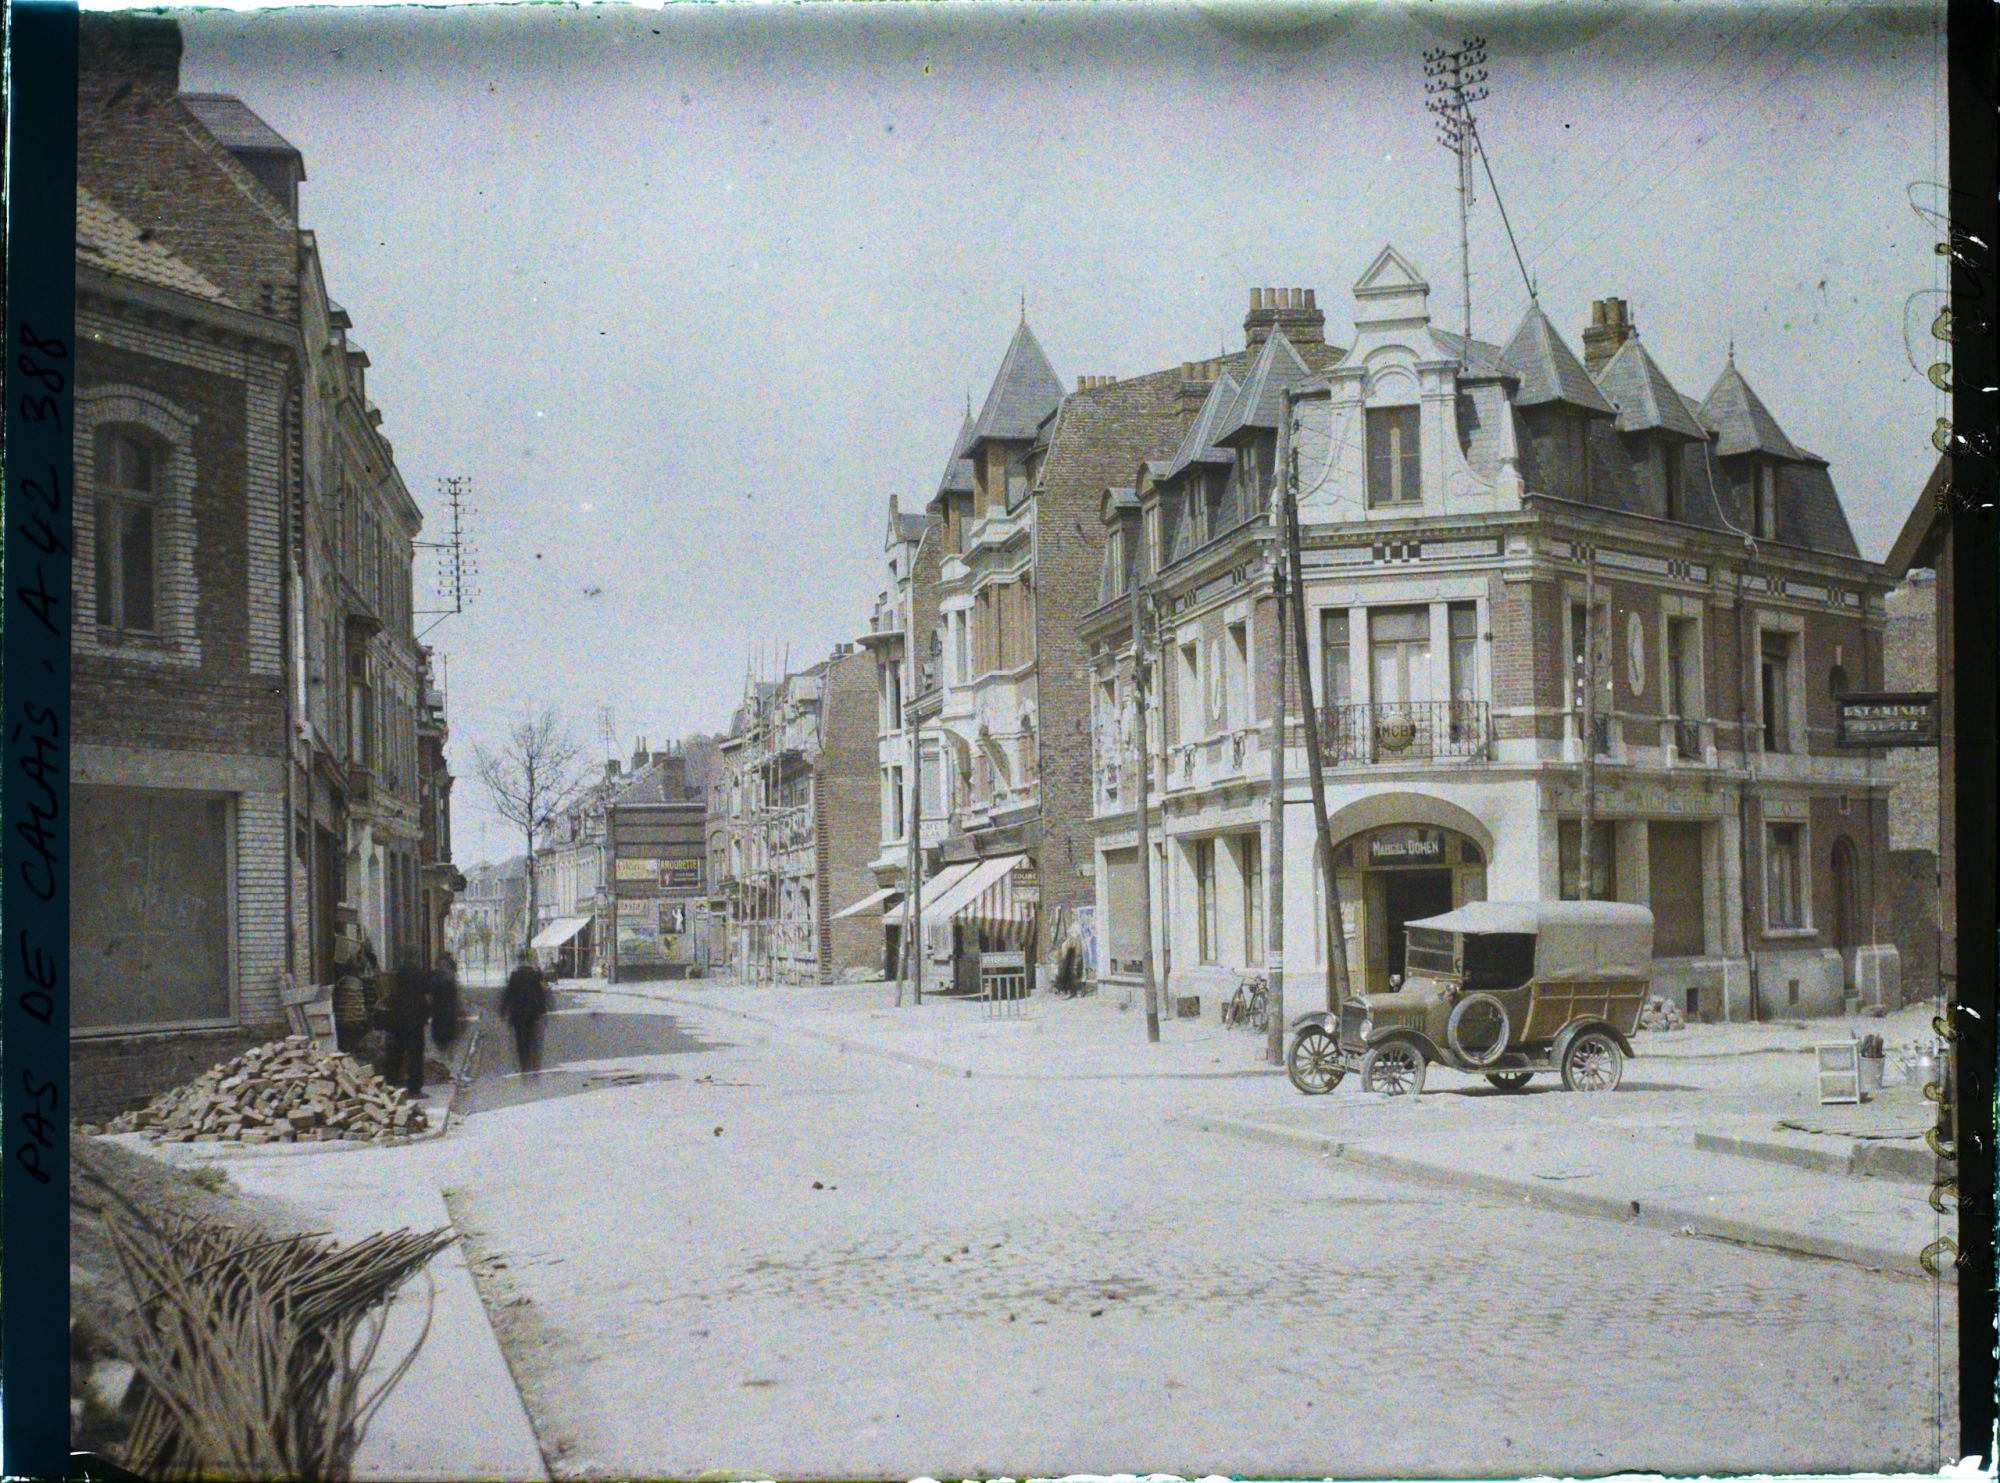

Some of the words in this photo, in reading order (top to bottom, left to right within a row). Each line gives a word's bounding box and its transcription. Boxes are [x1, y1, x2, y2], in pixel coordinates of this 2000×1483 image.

[17, 322, 67, 433] 388
[20, 929, 56, 1025] DE
[16, 1070, 58, 1185] PAS
